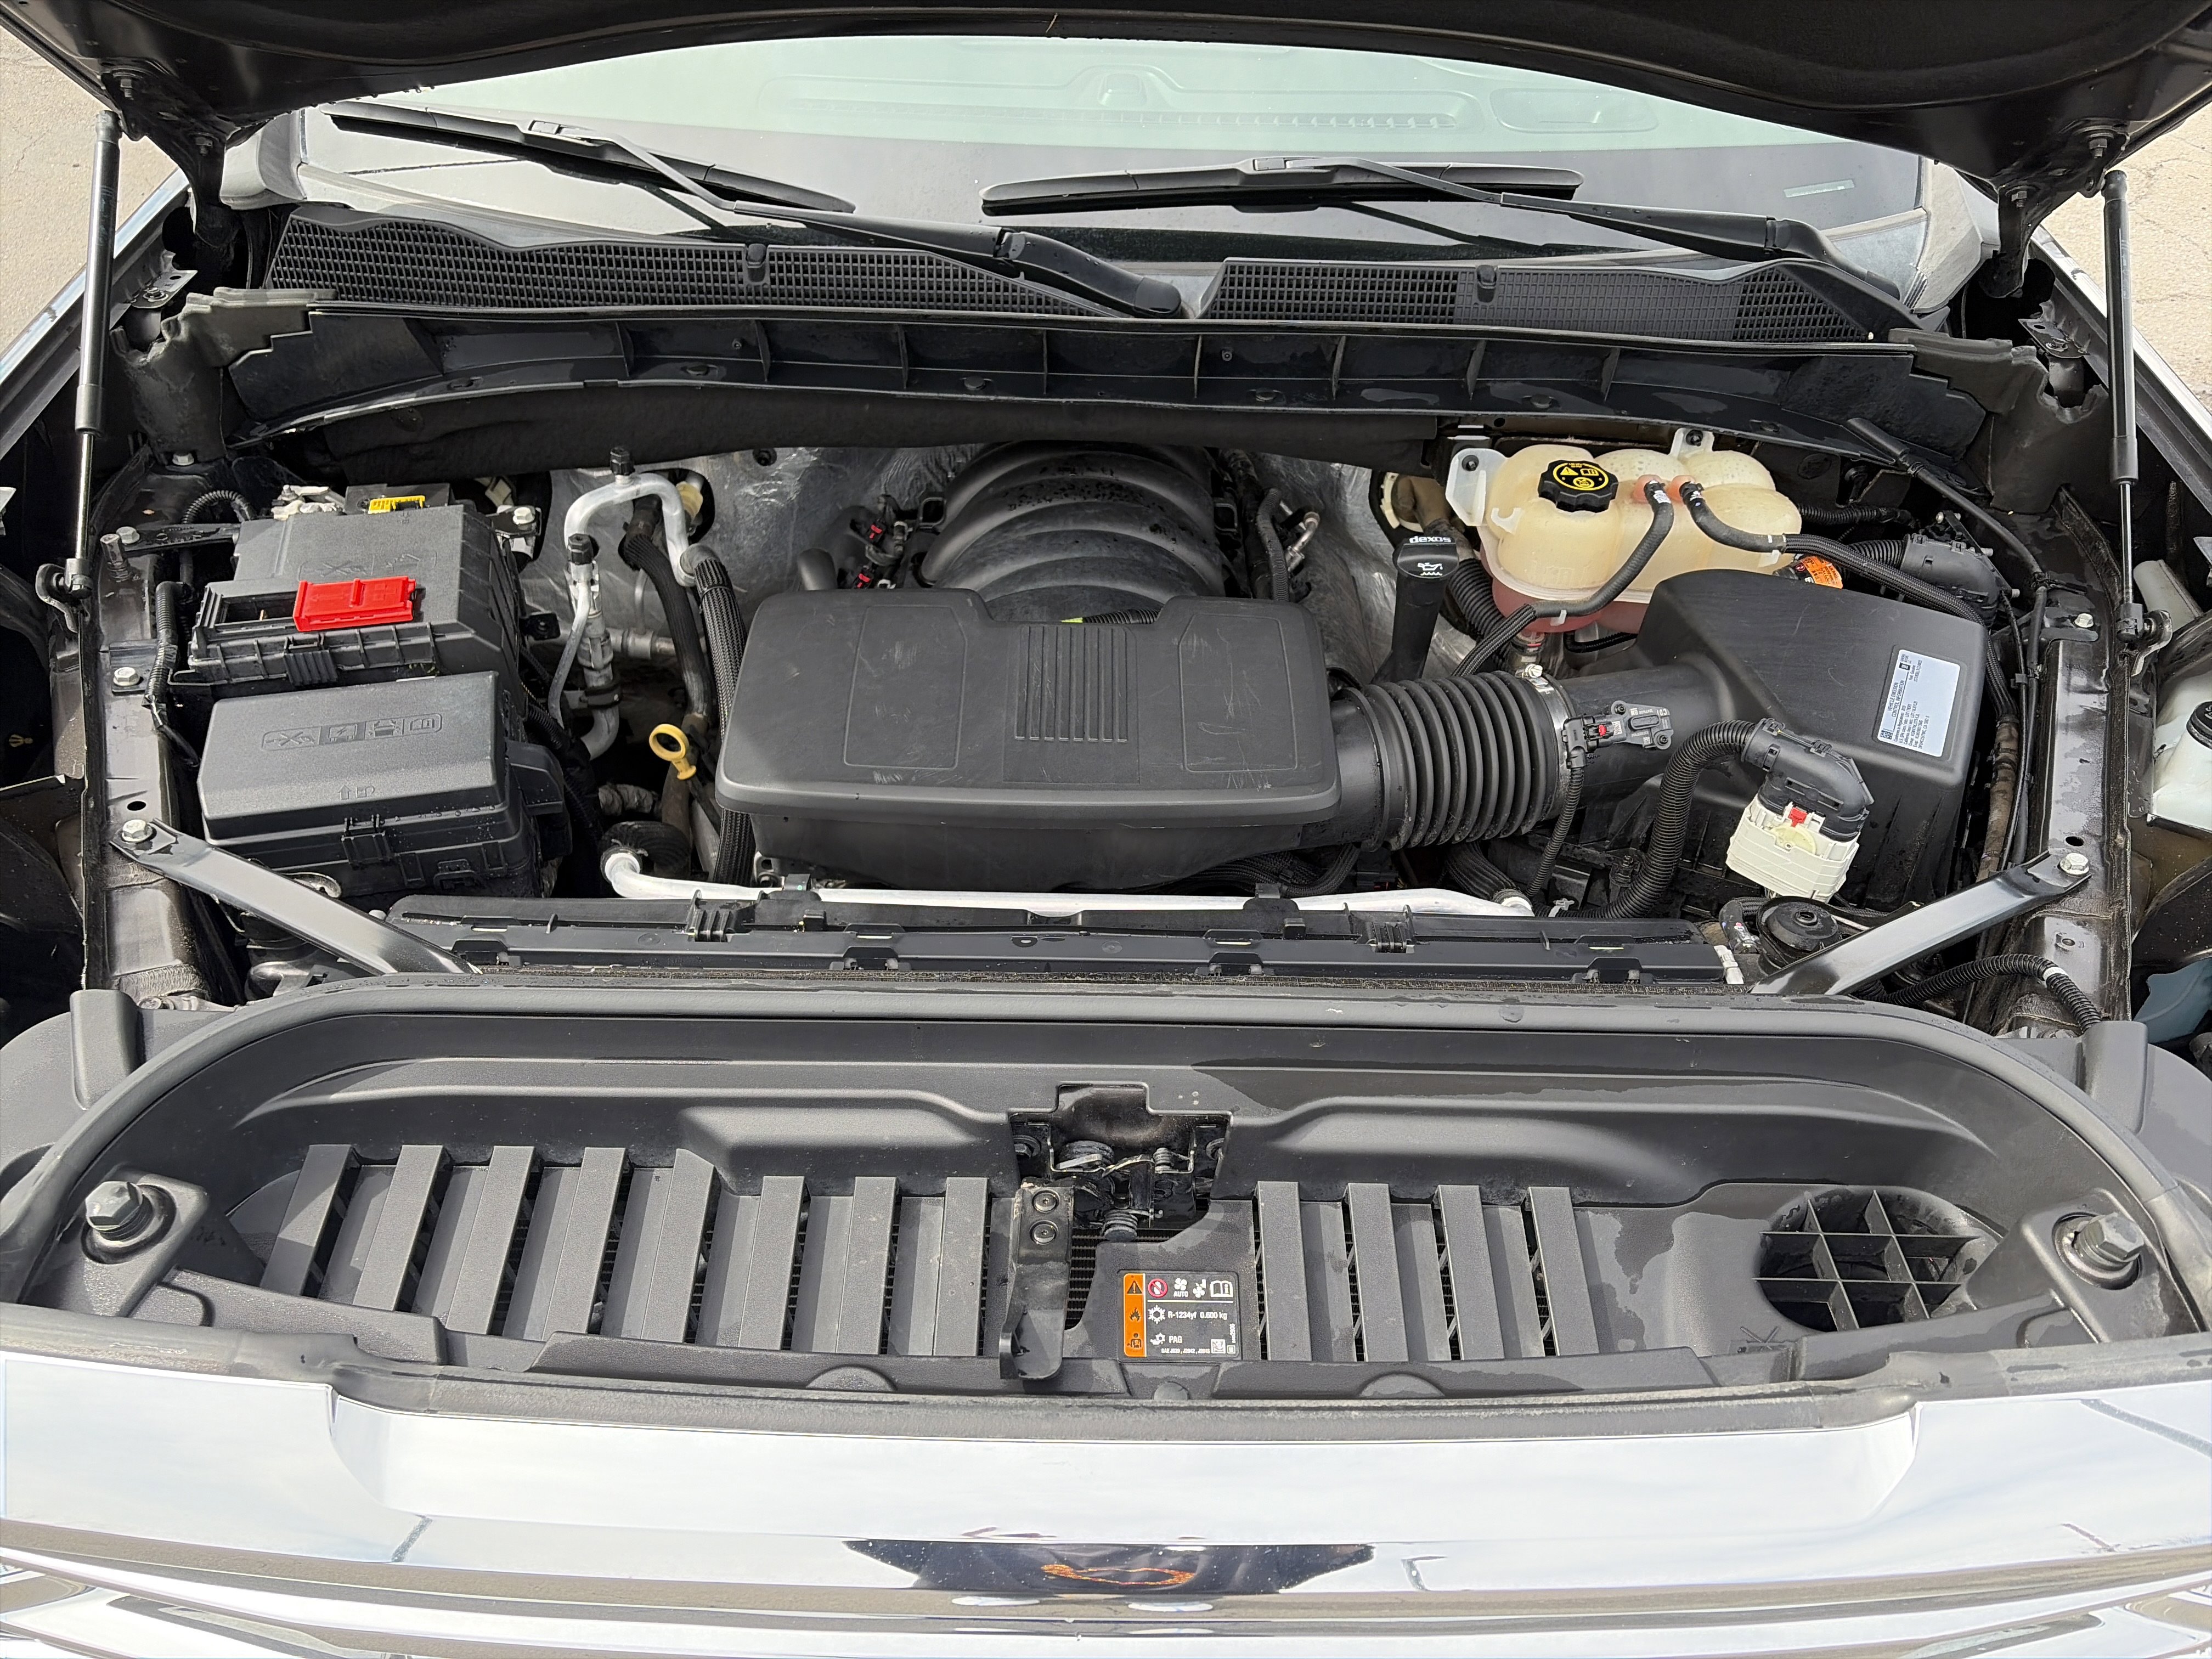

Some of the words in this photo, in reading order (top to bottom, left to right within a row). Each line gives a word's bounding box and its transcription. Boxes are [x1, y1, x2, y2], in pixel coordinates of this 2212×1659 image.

[1895, 680, 1904, 703] INFORMATION
[1167, 1311, 1197, 1319] R-1234yf
[1219, 1311, 1227, 1320] kg
